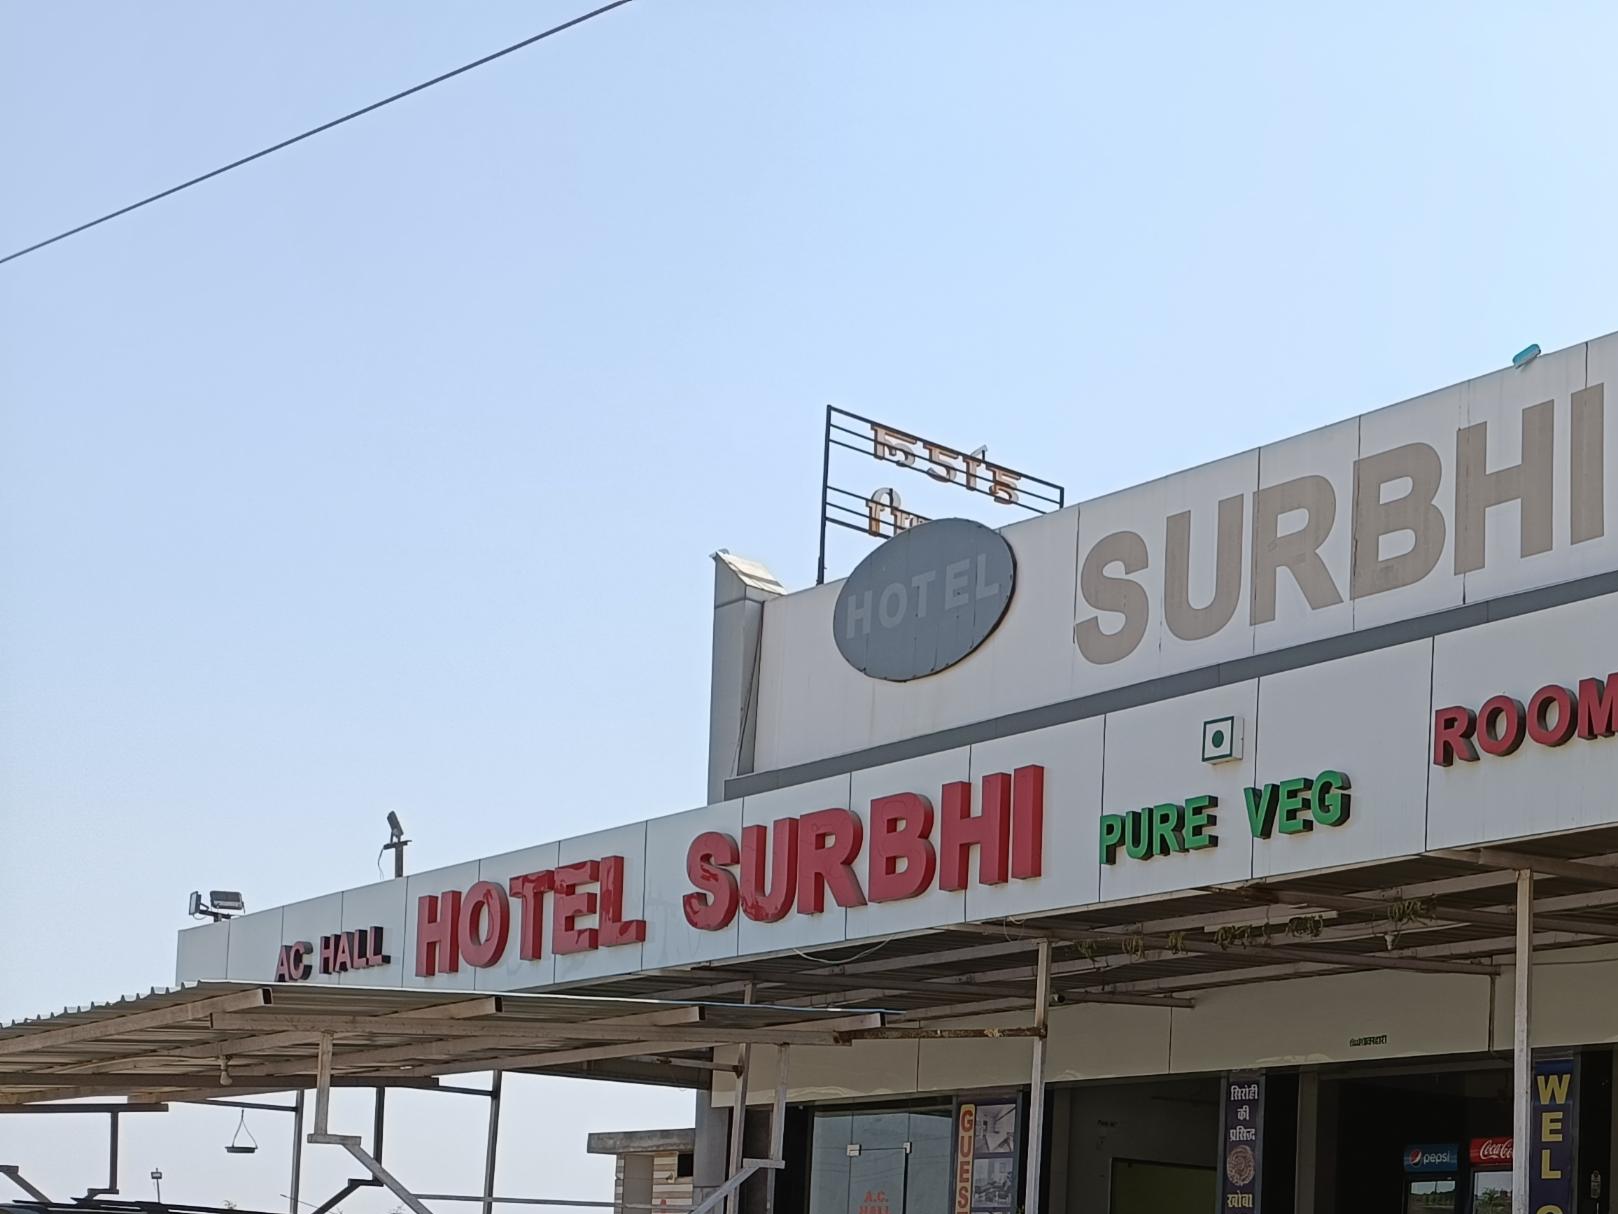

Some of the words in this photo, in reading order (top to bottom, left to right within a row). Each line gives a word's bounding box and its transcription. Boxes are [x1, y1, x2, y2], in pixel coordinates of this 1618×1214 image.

[1074, 385, 1605, 665] SURBHI
[846, 553, 1000, 640] HOTEL
[1099, 794, 1220, 866] PURE
[1243, 769, 1352, 840] VEG
[414, 854, 646, 978] HOTEL
[682, 764, 1045, 931] SURBHI
[274, 940, 313, 982] AC
[318, 926, 391, 975] HALL
[1230, 1083, 1259, 1102] सिरोही
[1236, 1105, 1250, 1121] की
[1423, 1150, 1451, 1165] pepsi
[1479, 1138, 1514, 1161] Coca-Co
